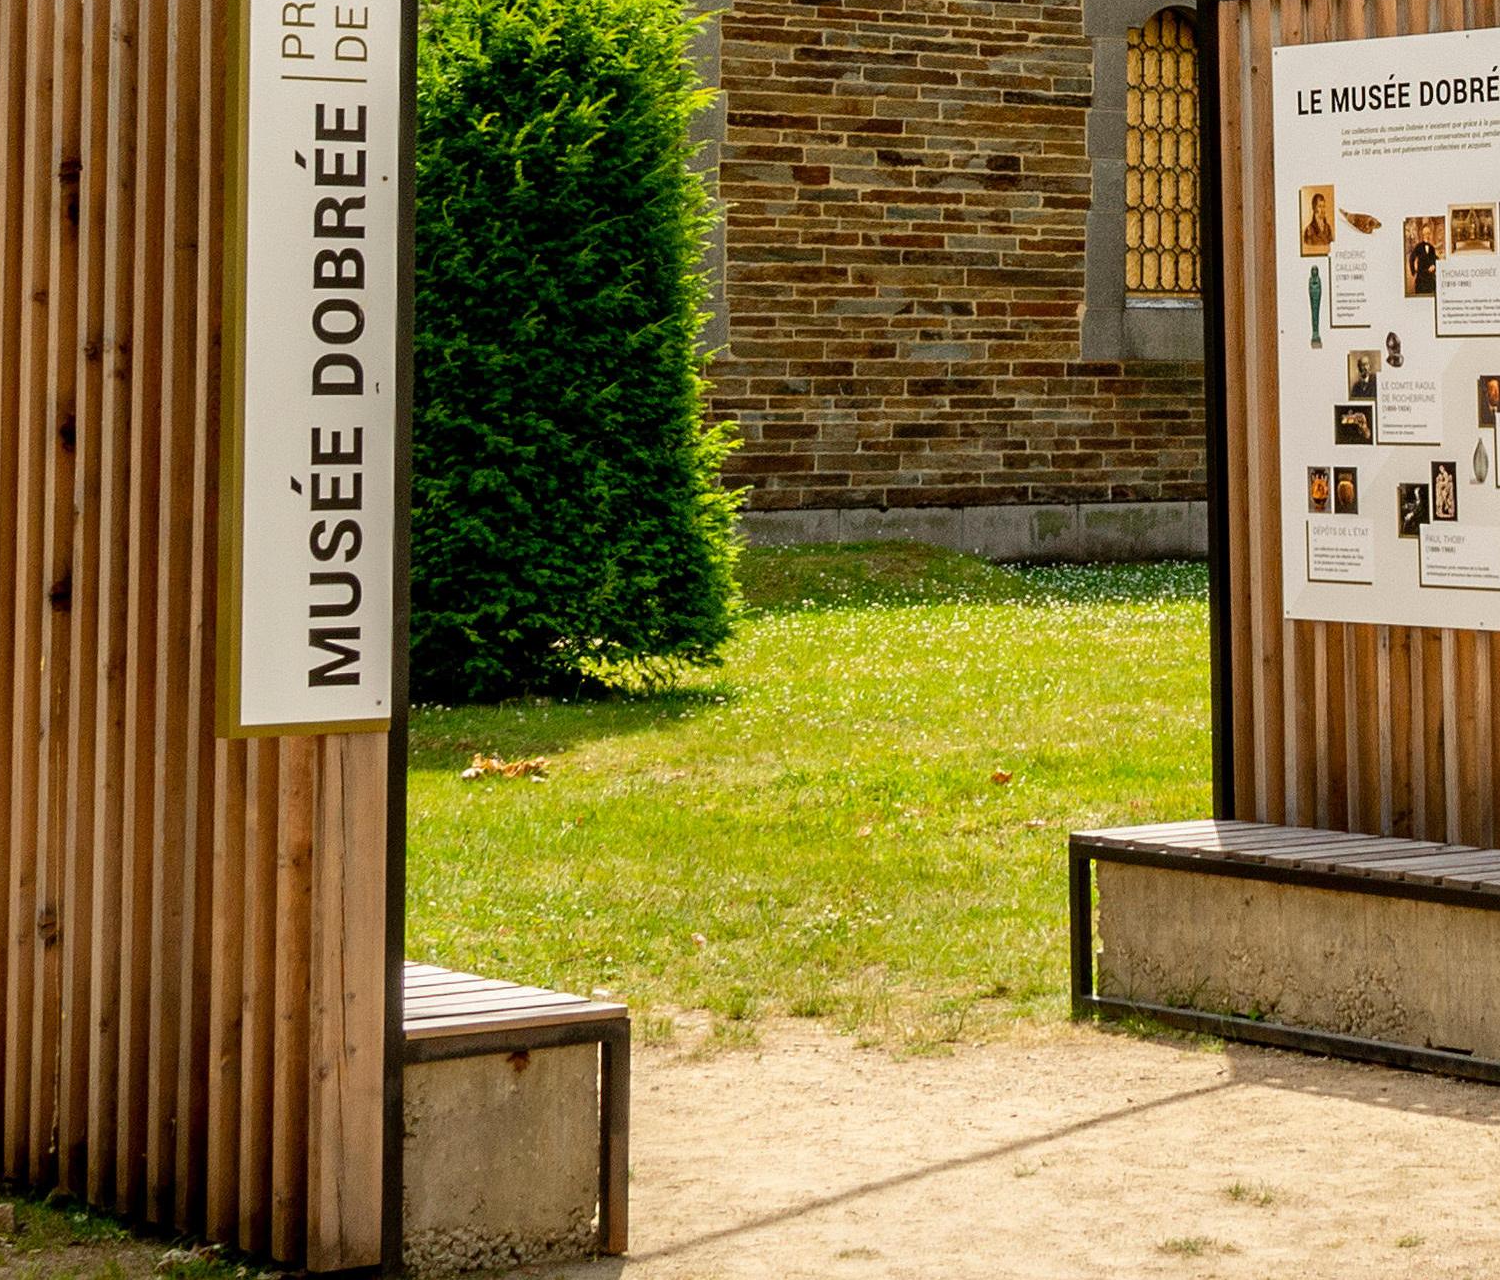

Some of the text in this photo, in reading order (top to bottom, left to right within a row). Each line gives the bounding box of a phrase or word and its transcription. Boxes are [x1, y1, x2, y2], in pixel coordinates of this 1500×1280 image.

[335, 5, 369, 63] DE
[1297, 89, 1323, 116] LE
[1331, 73, 1411, 114] MUSÉE
[290, 103, 368, 688] MUSÉE DOBRÉE
